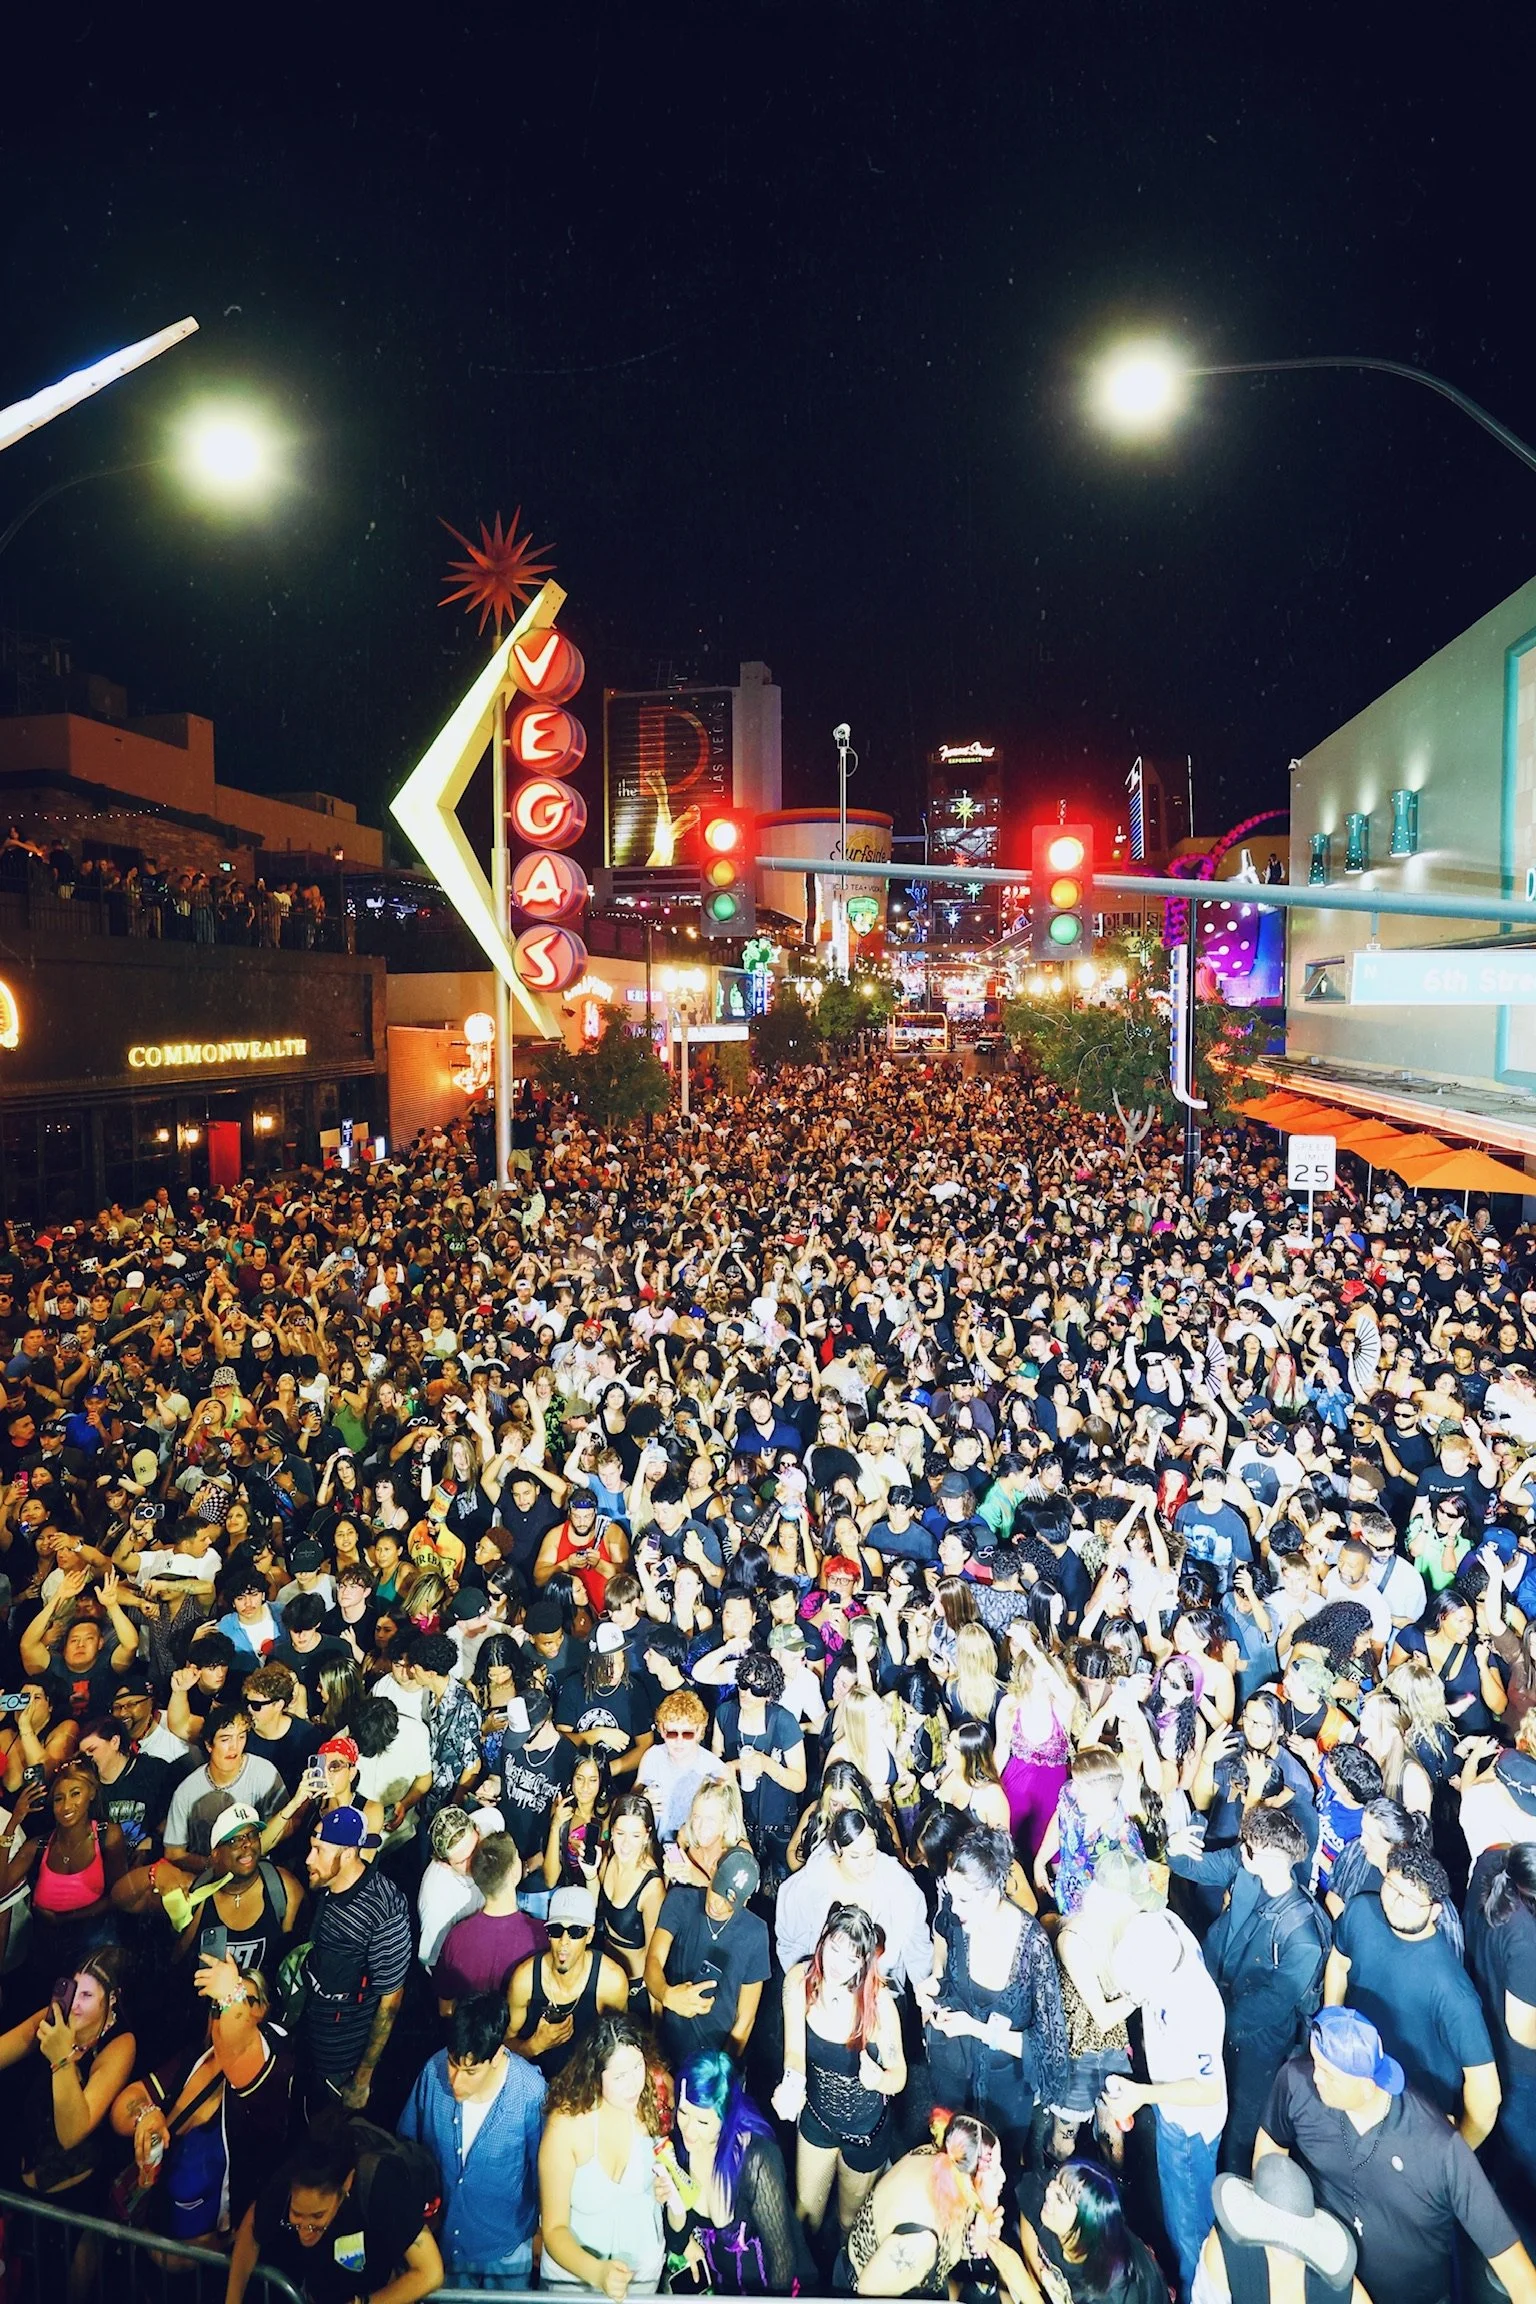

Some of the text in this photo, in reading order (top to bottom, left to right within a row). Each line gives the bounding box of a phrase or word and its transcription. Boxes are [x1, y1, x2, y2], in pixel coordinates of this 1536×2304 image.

[618, 706, 710, 797] the D
[712, 763, 725, 793] LAS
[513, 633, 573, 986] VEGAS
[1422, 967, 1468, 993] 6th
[128, 1039, 307, 1068] COMMONWEALTH
[1294, 1165, 1329, 1183] 25
[1198, 2053, 1214, 2075] 2
